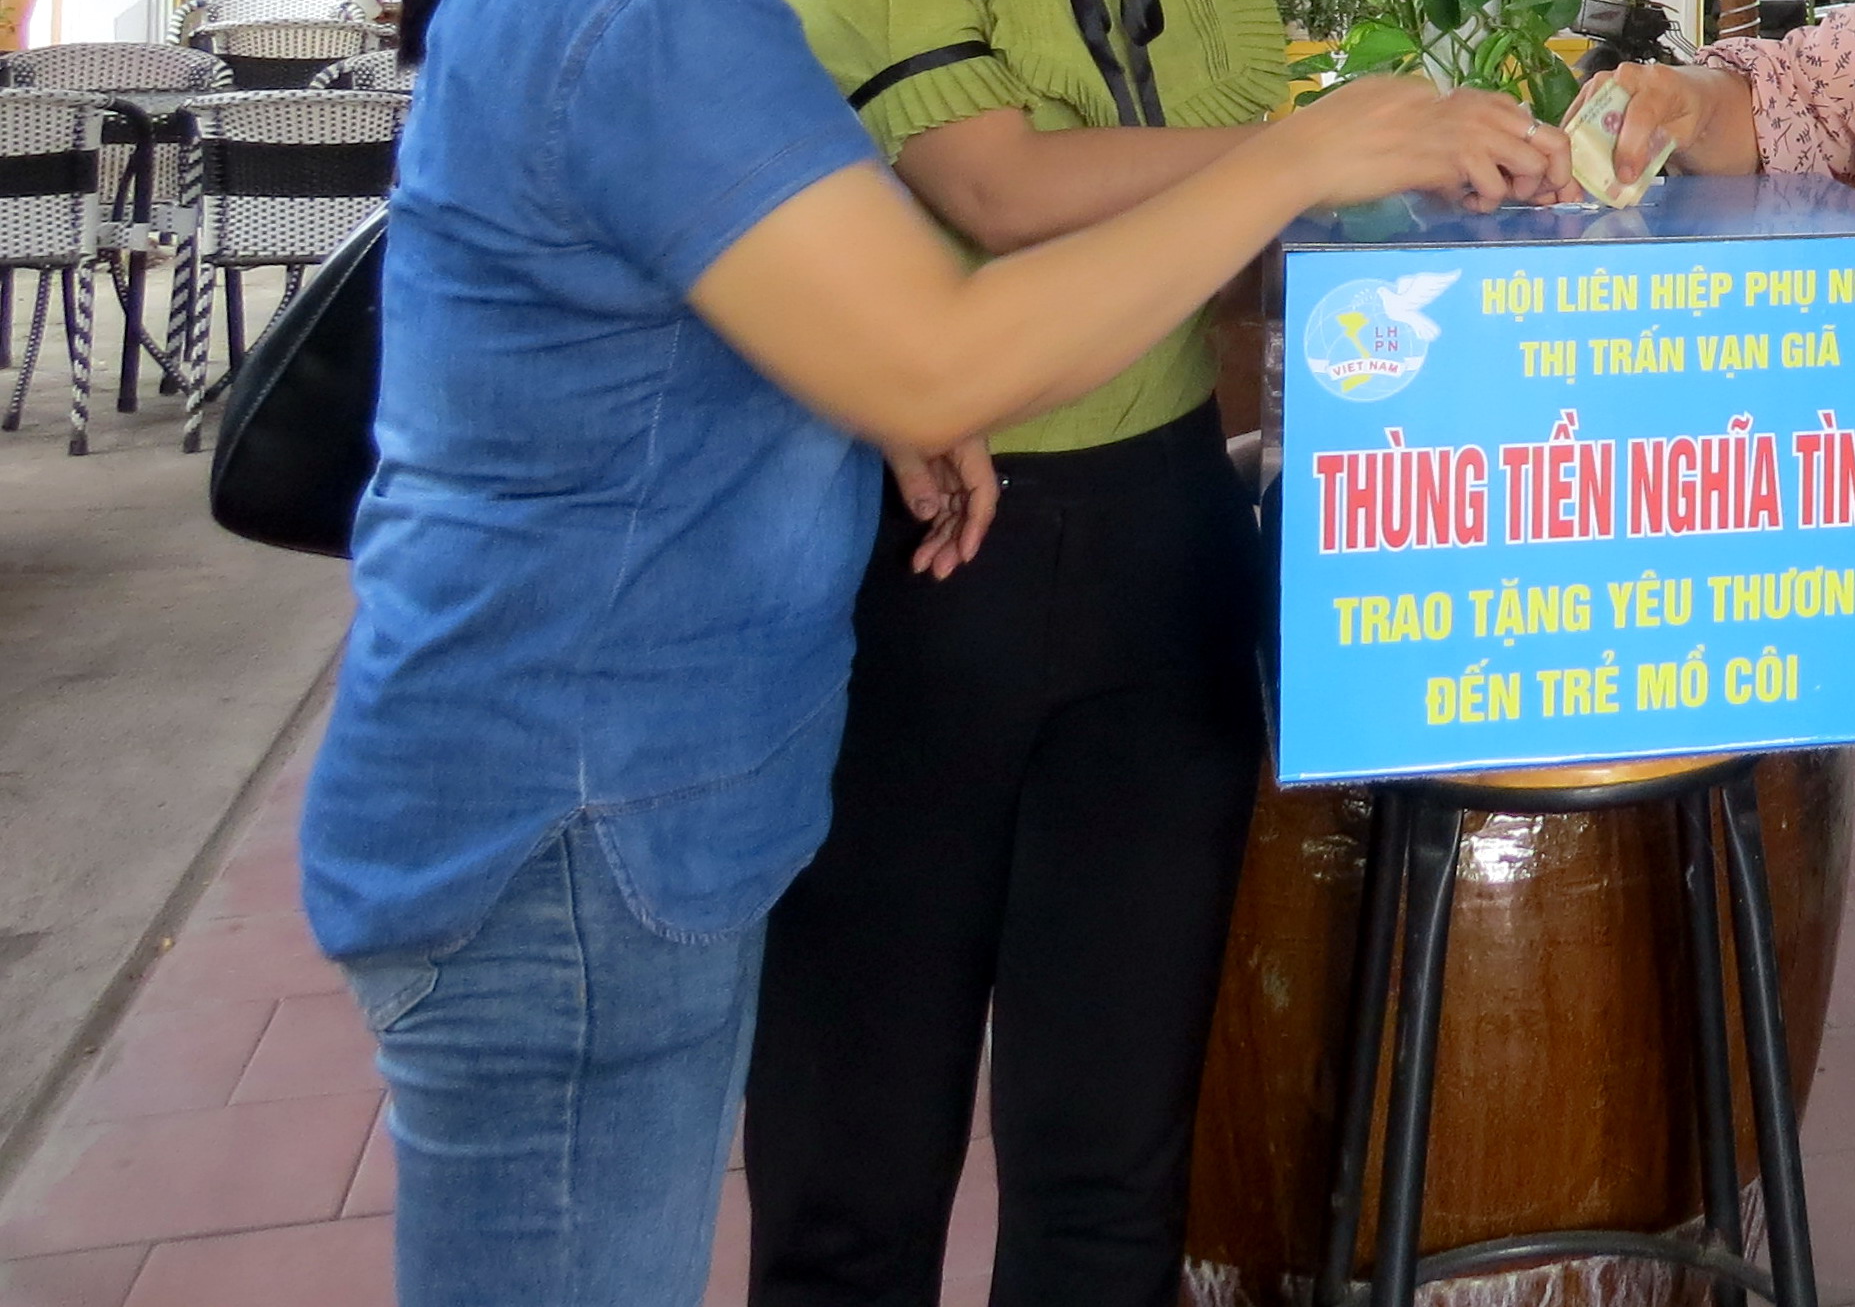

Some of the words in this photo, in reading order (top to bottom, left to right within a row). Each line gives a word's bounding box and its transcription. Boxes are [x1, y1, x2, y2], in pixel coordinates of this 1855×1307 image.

[1481, 269, 1545, 323] HỘI
[1556, 267, 1639, 313] LIÊN
[1650, 264, 1733, 317] HIỆP
[1744, 269, 1817, 314] PHỤ
[1369, 360, 1398, 373] NAM
[1519, 339, 1578, 385] THỊ
[1588, 323, 1686, 376] TRẤN
[1696, 333, 1770, 379] VẠN
[1781, 324, 1841, 369] GIÃ
[1313, 426, 1489, 555] THÙNG
[1499, 408, 1617, 545] TIỀN
[1626, 412, 1784, 538] NGHĨA
[1333, 591, 1454, 646] TRAO
[1468, 578, 1592, 647] TẶNG
[1607, 569, 1694, 629] YÊU
[1424, 659, 1522, 726] ĐẾN
[1536, 649, 1621, 718] TRẺ
[1636, 644, 1710, 711] MỒ
[1724, 645, 1799, 705] CÔI
